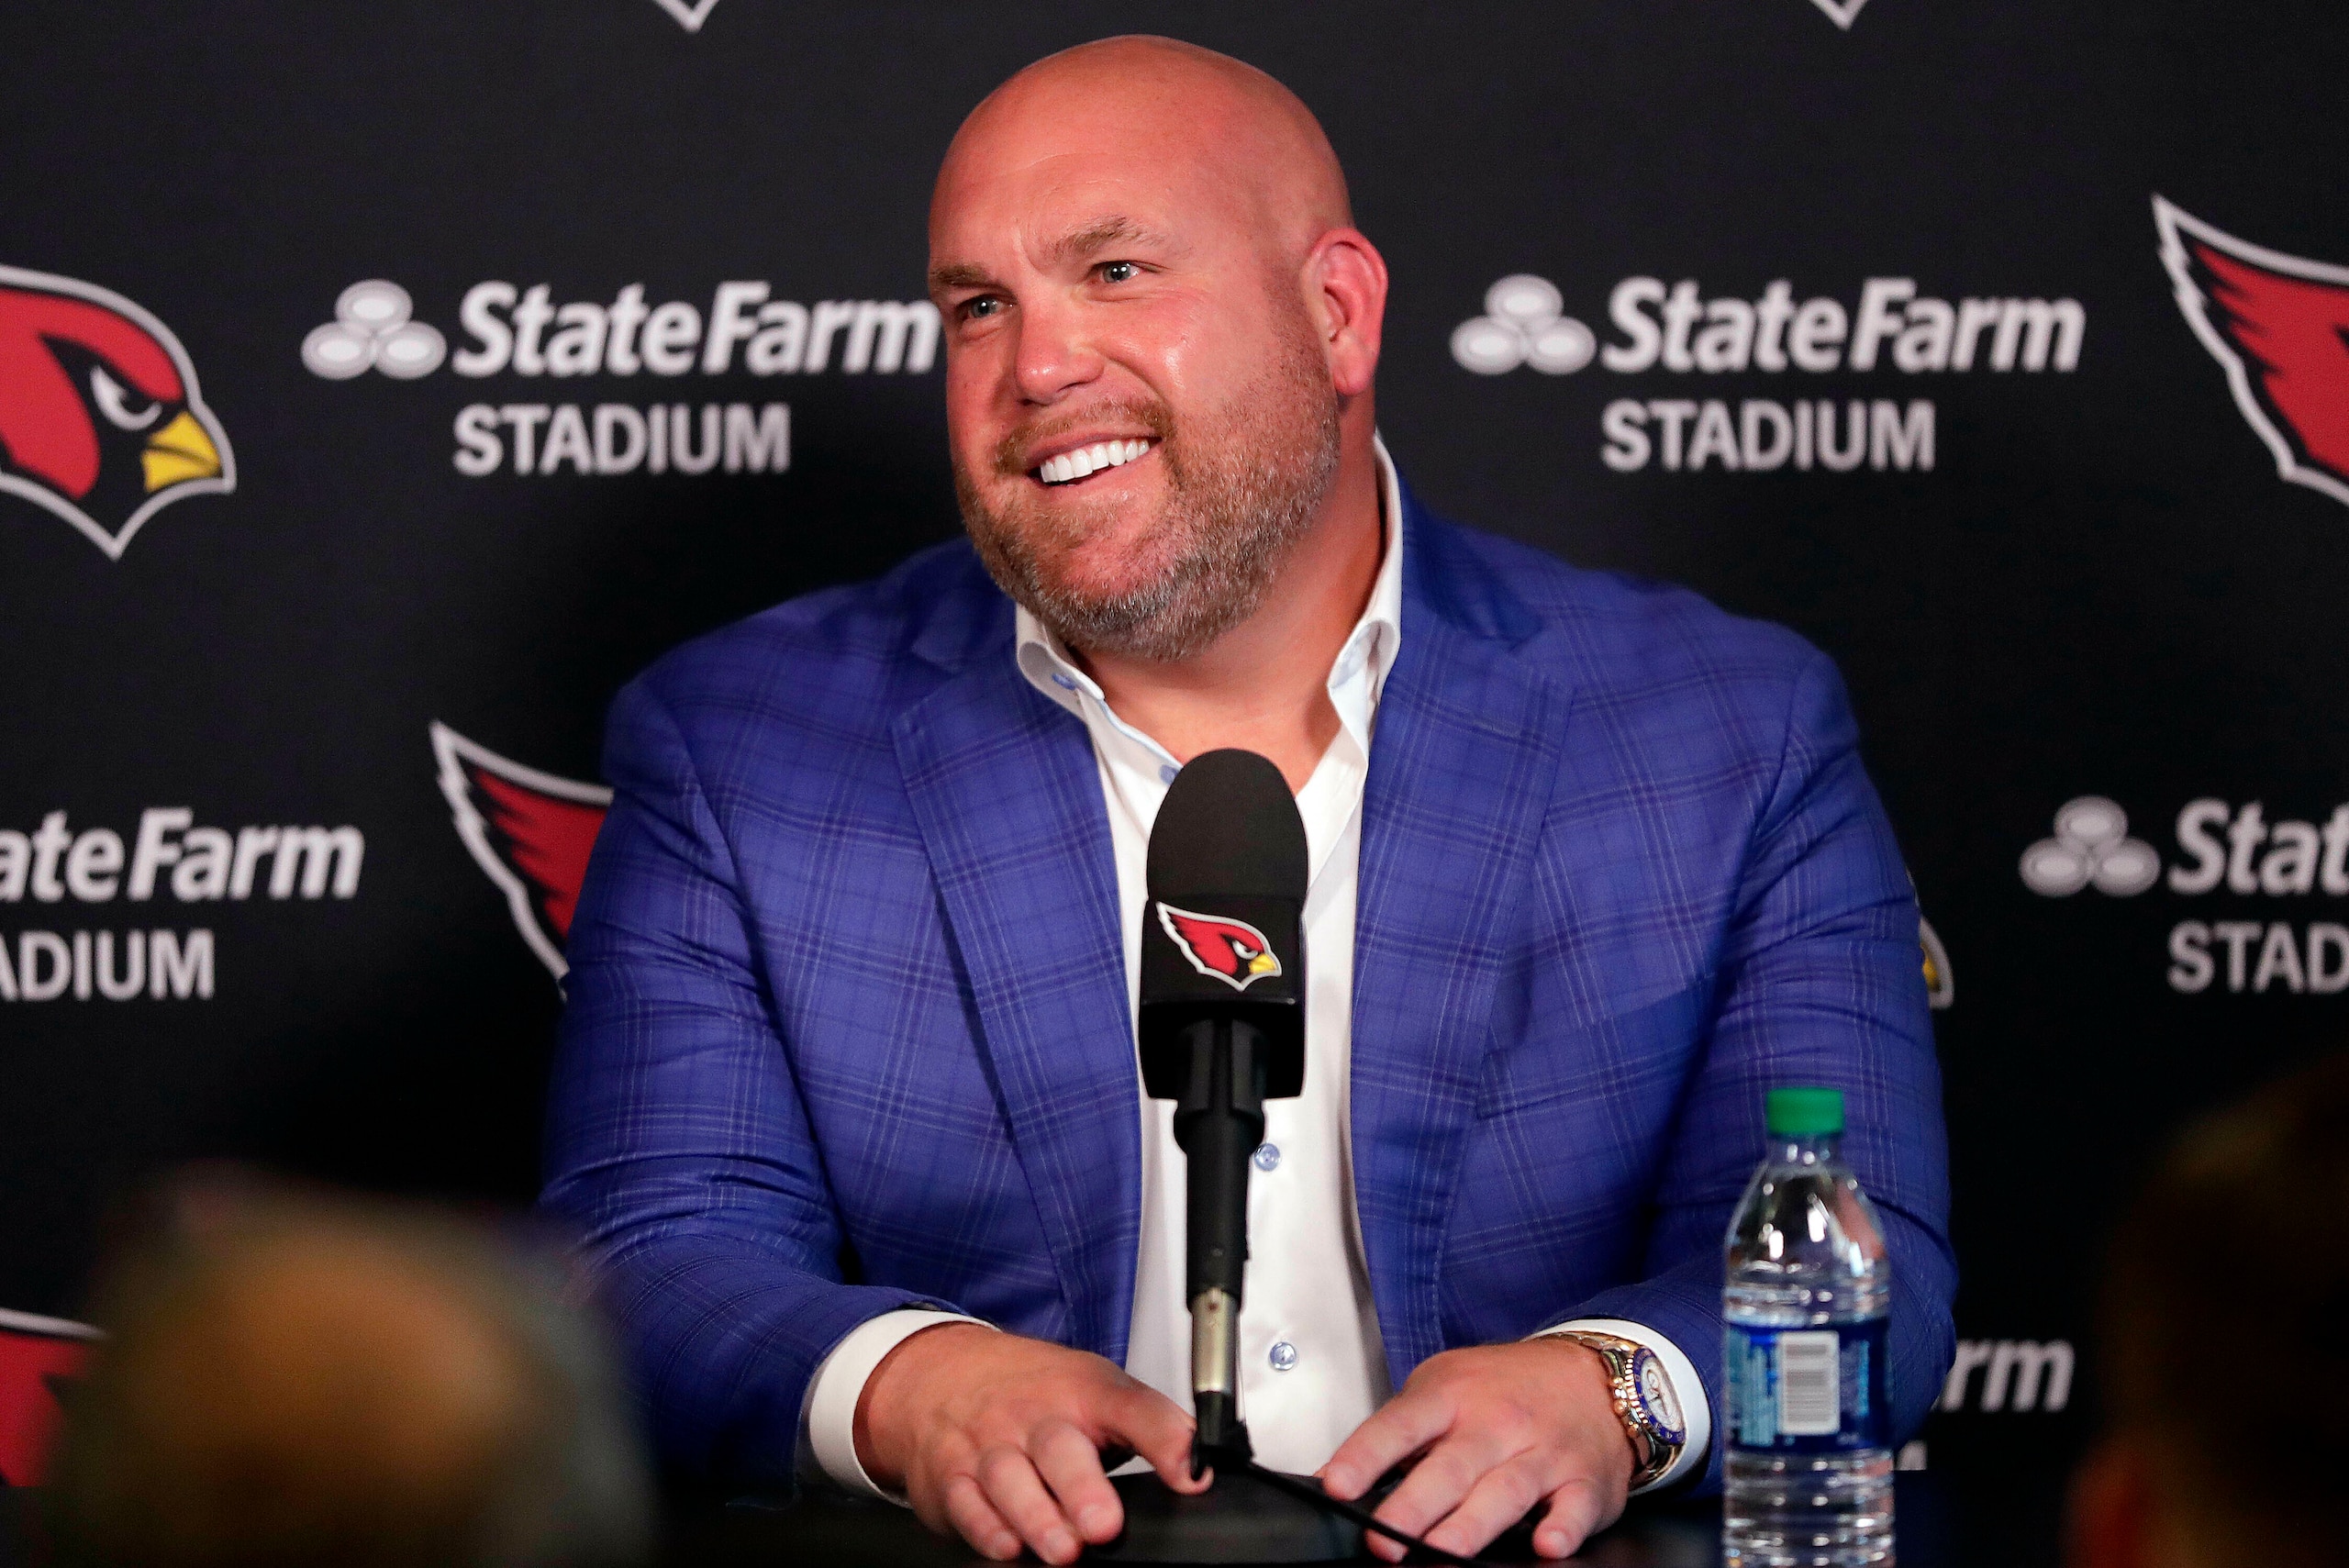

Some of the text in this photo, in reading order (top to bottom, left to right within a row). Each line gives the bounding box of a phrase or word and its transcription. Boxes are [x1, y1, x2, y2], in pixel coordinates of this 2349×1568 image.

[451, 402, 792, 477] STADIUM
[1599, 397, 1936, 472] STADIUM
[2167, 920, 2349, 994] STAD
